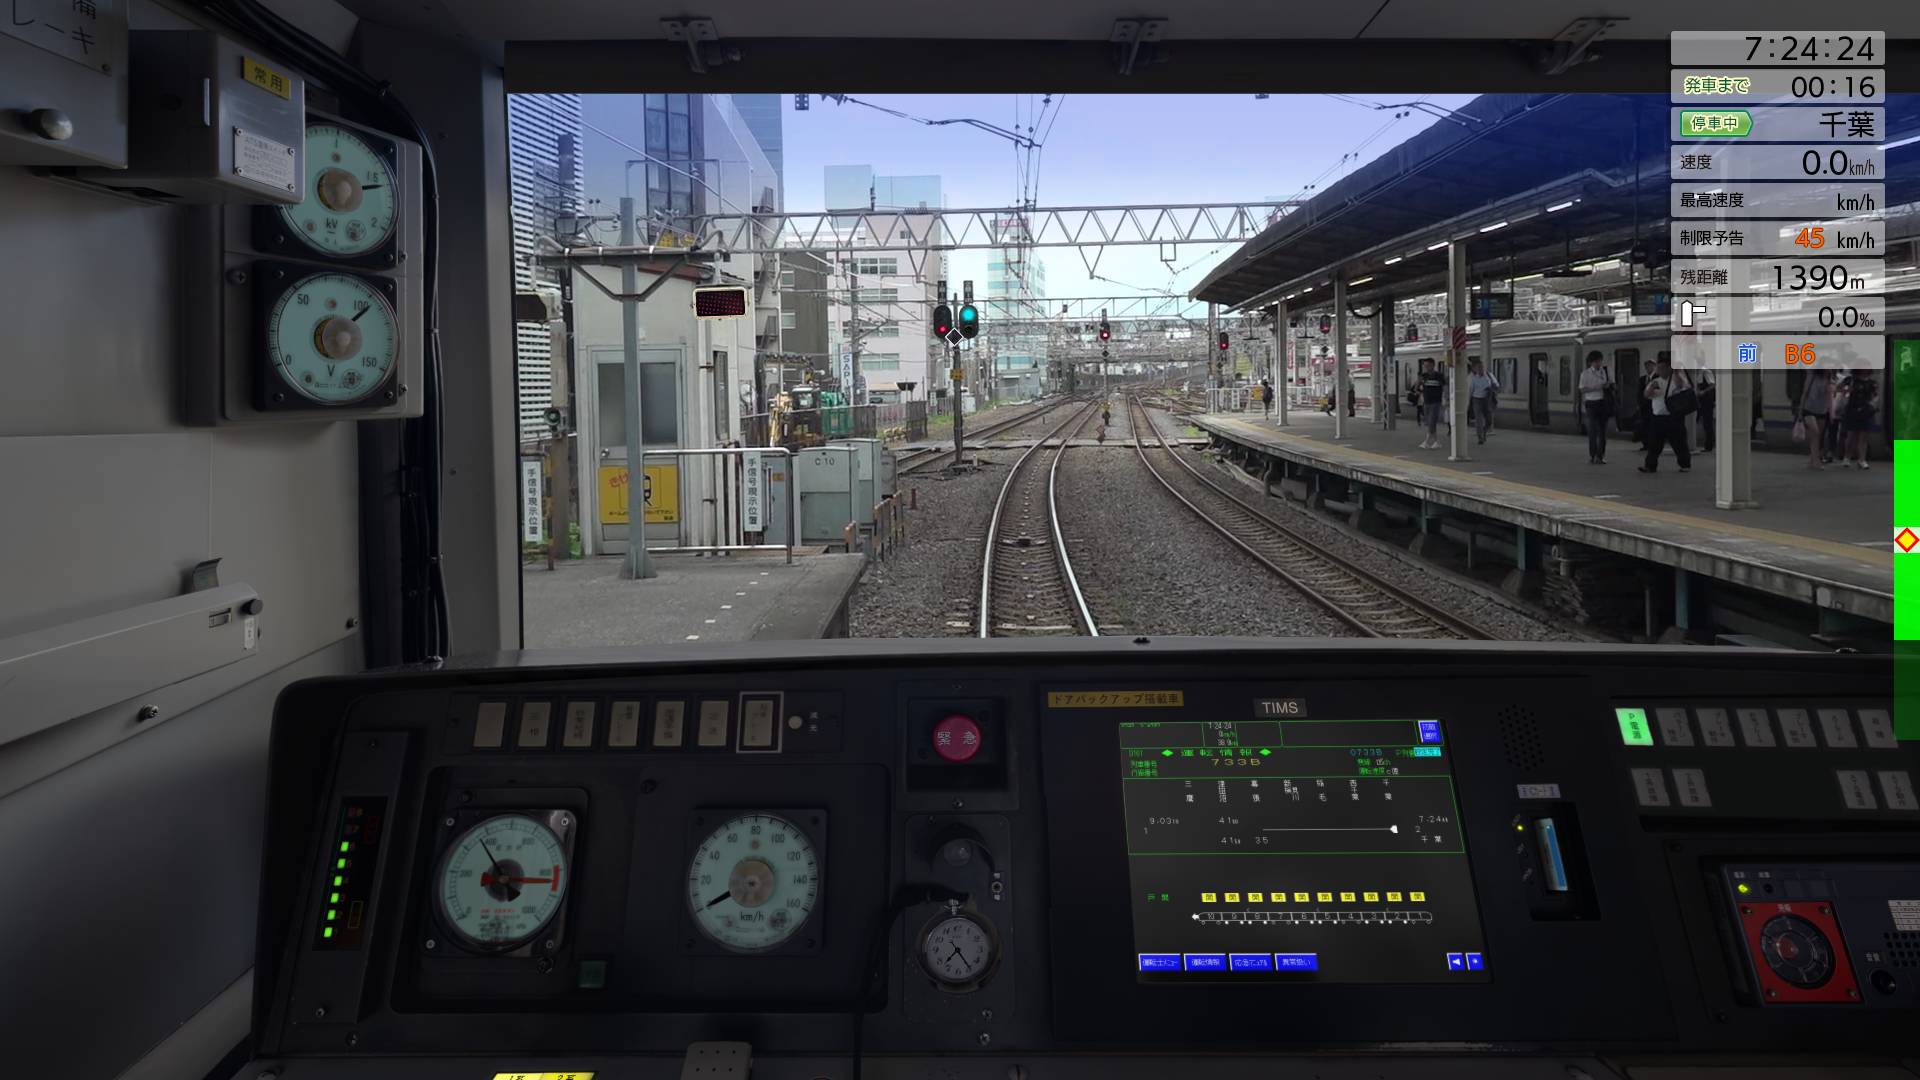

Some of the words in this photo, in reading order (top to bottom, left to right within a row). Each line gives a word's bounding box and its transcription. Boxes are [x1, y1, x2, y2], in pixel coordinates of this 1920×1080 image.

[254, 66, 282, 92] 常用
[367, 170, 378, 182] 1.5
[326, 218, 338, 230] kV
[371, 218, 378, 228] 2
[297, 294, 309, 305] 50
[354, 300, 368, 310] 100
[286, 354, 291, 365] 0
[362, 357, 377, 367] 150
[327, 364, 335, 377] V
[748, 458, 758, 525] 手信号現示位置
[527, 468, 538, 535] 手信号現示位置
[1055, 693, 1180, 704] ドアバックアップ搭載車
[1262, 702, 1298, 714] TIMS
[529, 712, 540, 736] 三相
[708, 712, 718, 735] 定速
[810, 711, 818, 732] 減光
[1628, 713, 1642, 739] P電源
[938, 731, 976, 745] 緊急
[356, 808, 363, 816] 8
[751, 826, 760, 835] 80
[727, 834, 737, 843] 60
[771, 834, 785, 843] 100
[710, 851, 719, 860] 40
[787, 852, 801, 861] 120
[346, 860, 352, 868] 5
[701, 875, 711, 884] 20
[793, 875, 807, 884] 140
[786, 899, 800, 908] 160
[336, 911, 343, 919] 2
[740, 911, 764, 922] km/h
[586, 970, 599, 978] EB
